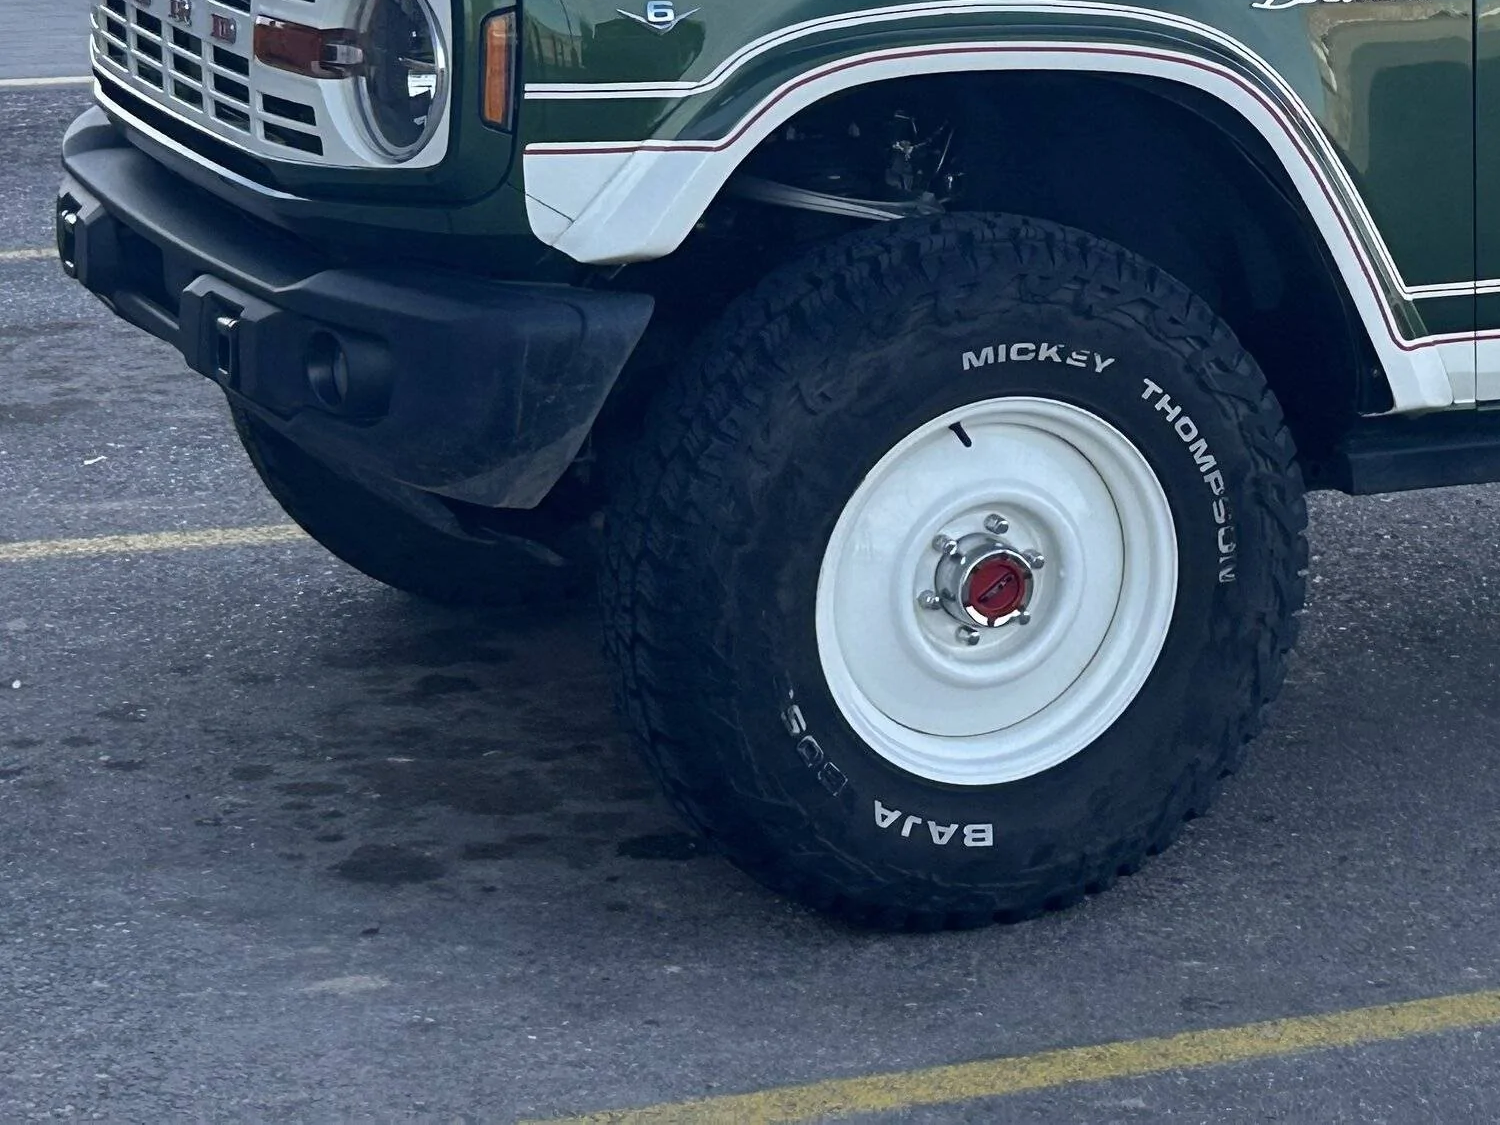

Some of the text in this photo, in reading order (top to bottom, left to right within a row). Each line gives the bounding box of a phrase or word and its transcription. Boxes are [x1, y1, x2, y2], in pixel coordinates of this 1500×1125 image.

[962, 342, 1238, 583] MICKEY THOMPSON
[874, 800, 994, 848] BAJA
